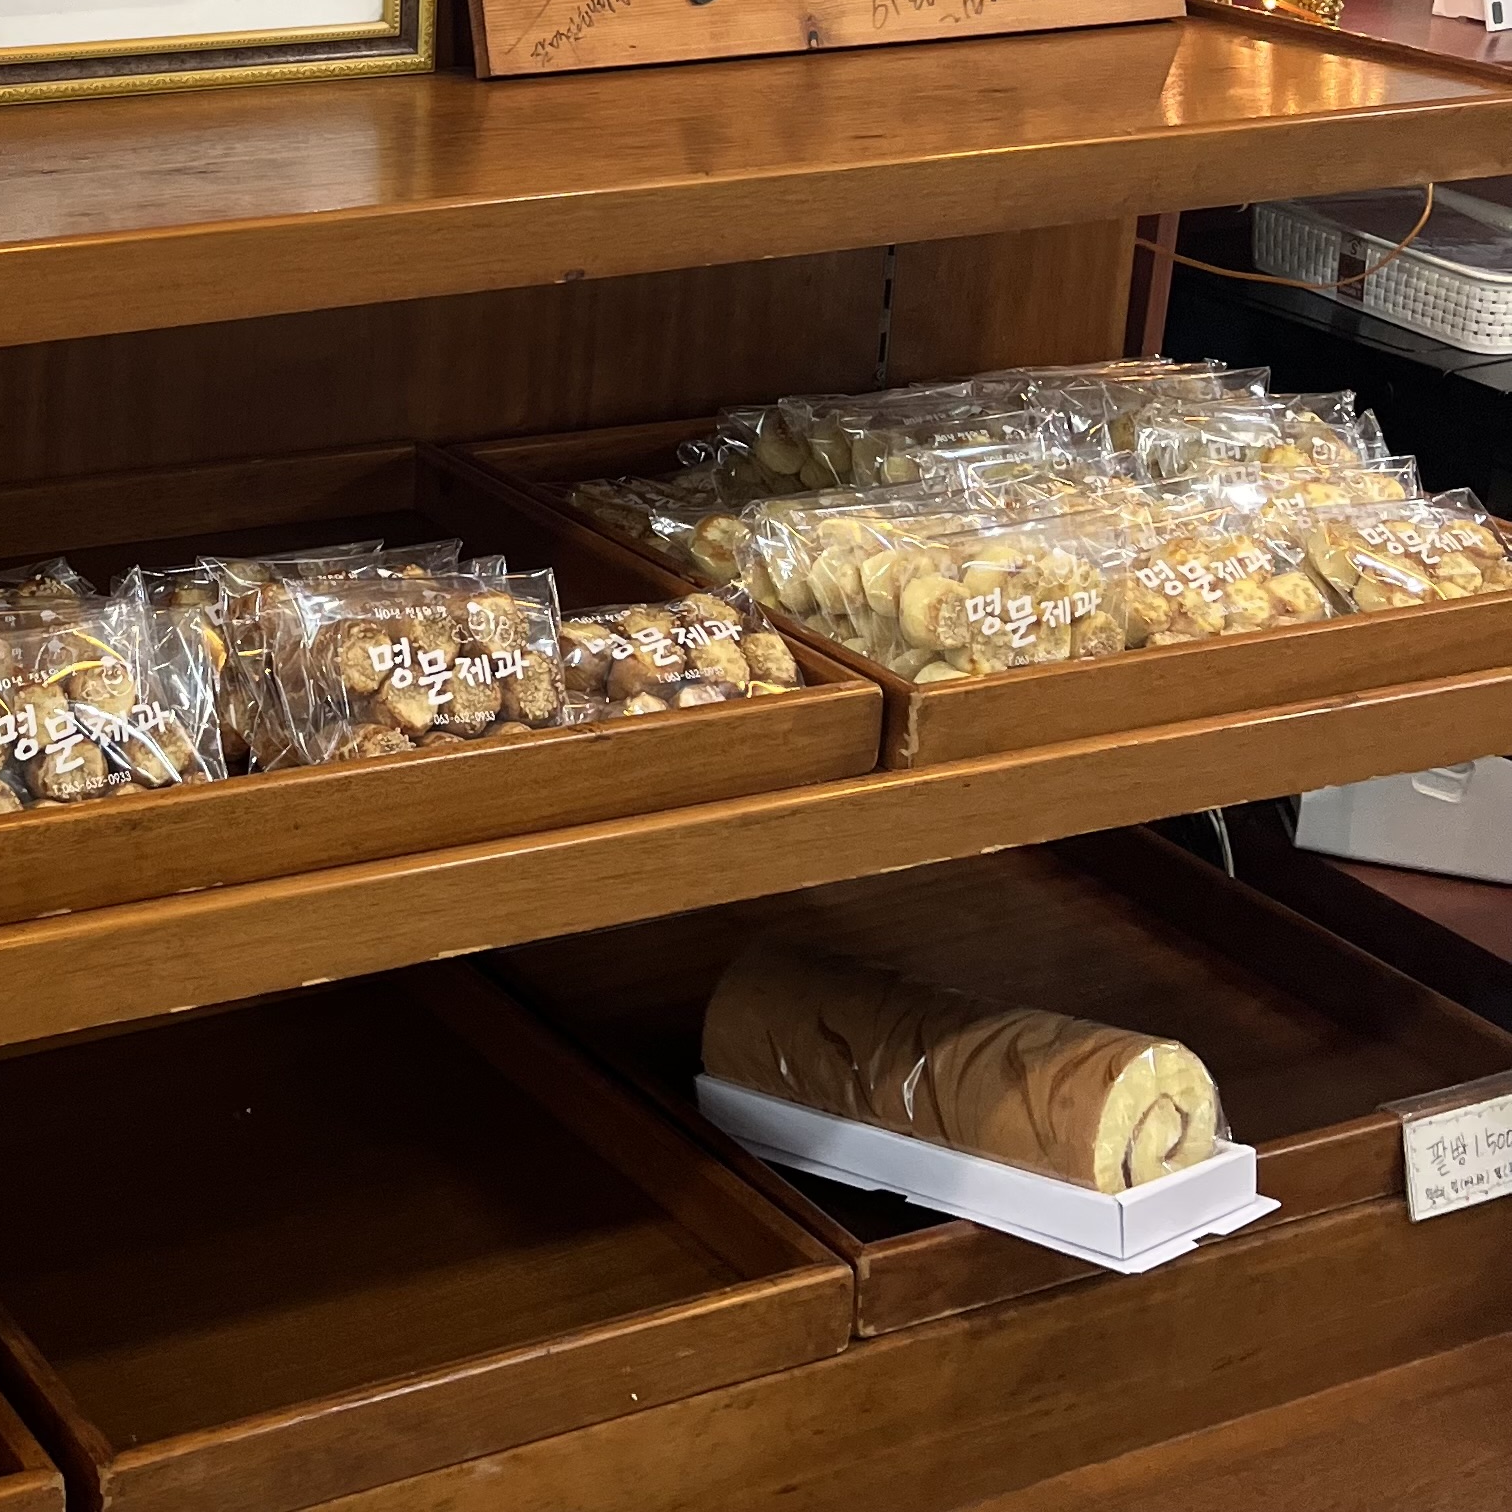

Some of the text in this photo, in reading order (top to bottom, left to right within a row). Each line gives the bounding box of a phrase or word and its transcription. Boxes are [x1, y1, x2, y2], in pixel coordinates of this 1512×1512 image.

[1357, 522, 1486, 564] 명문제과
[1134, 548, 1273, 603] 명문제과
[584, 619, 743, 667] 명문제과
[964, 587, 1103, 649] 명문제과
[368, 637, 530, 705] 명문제과
